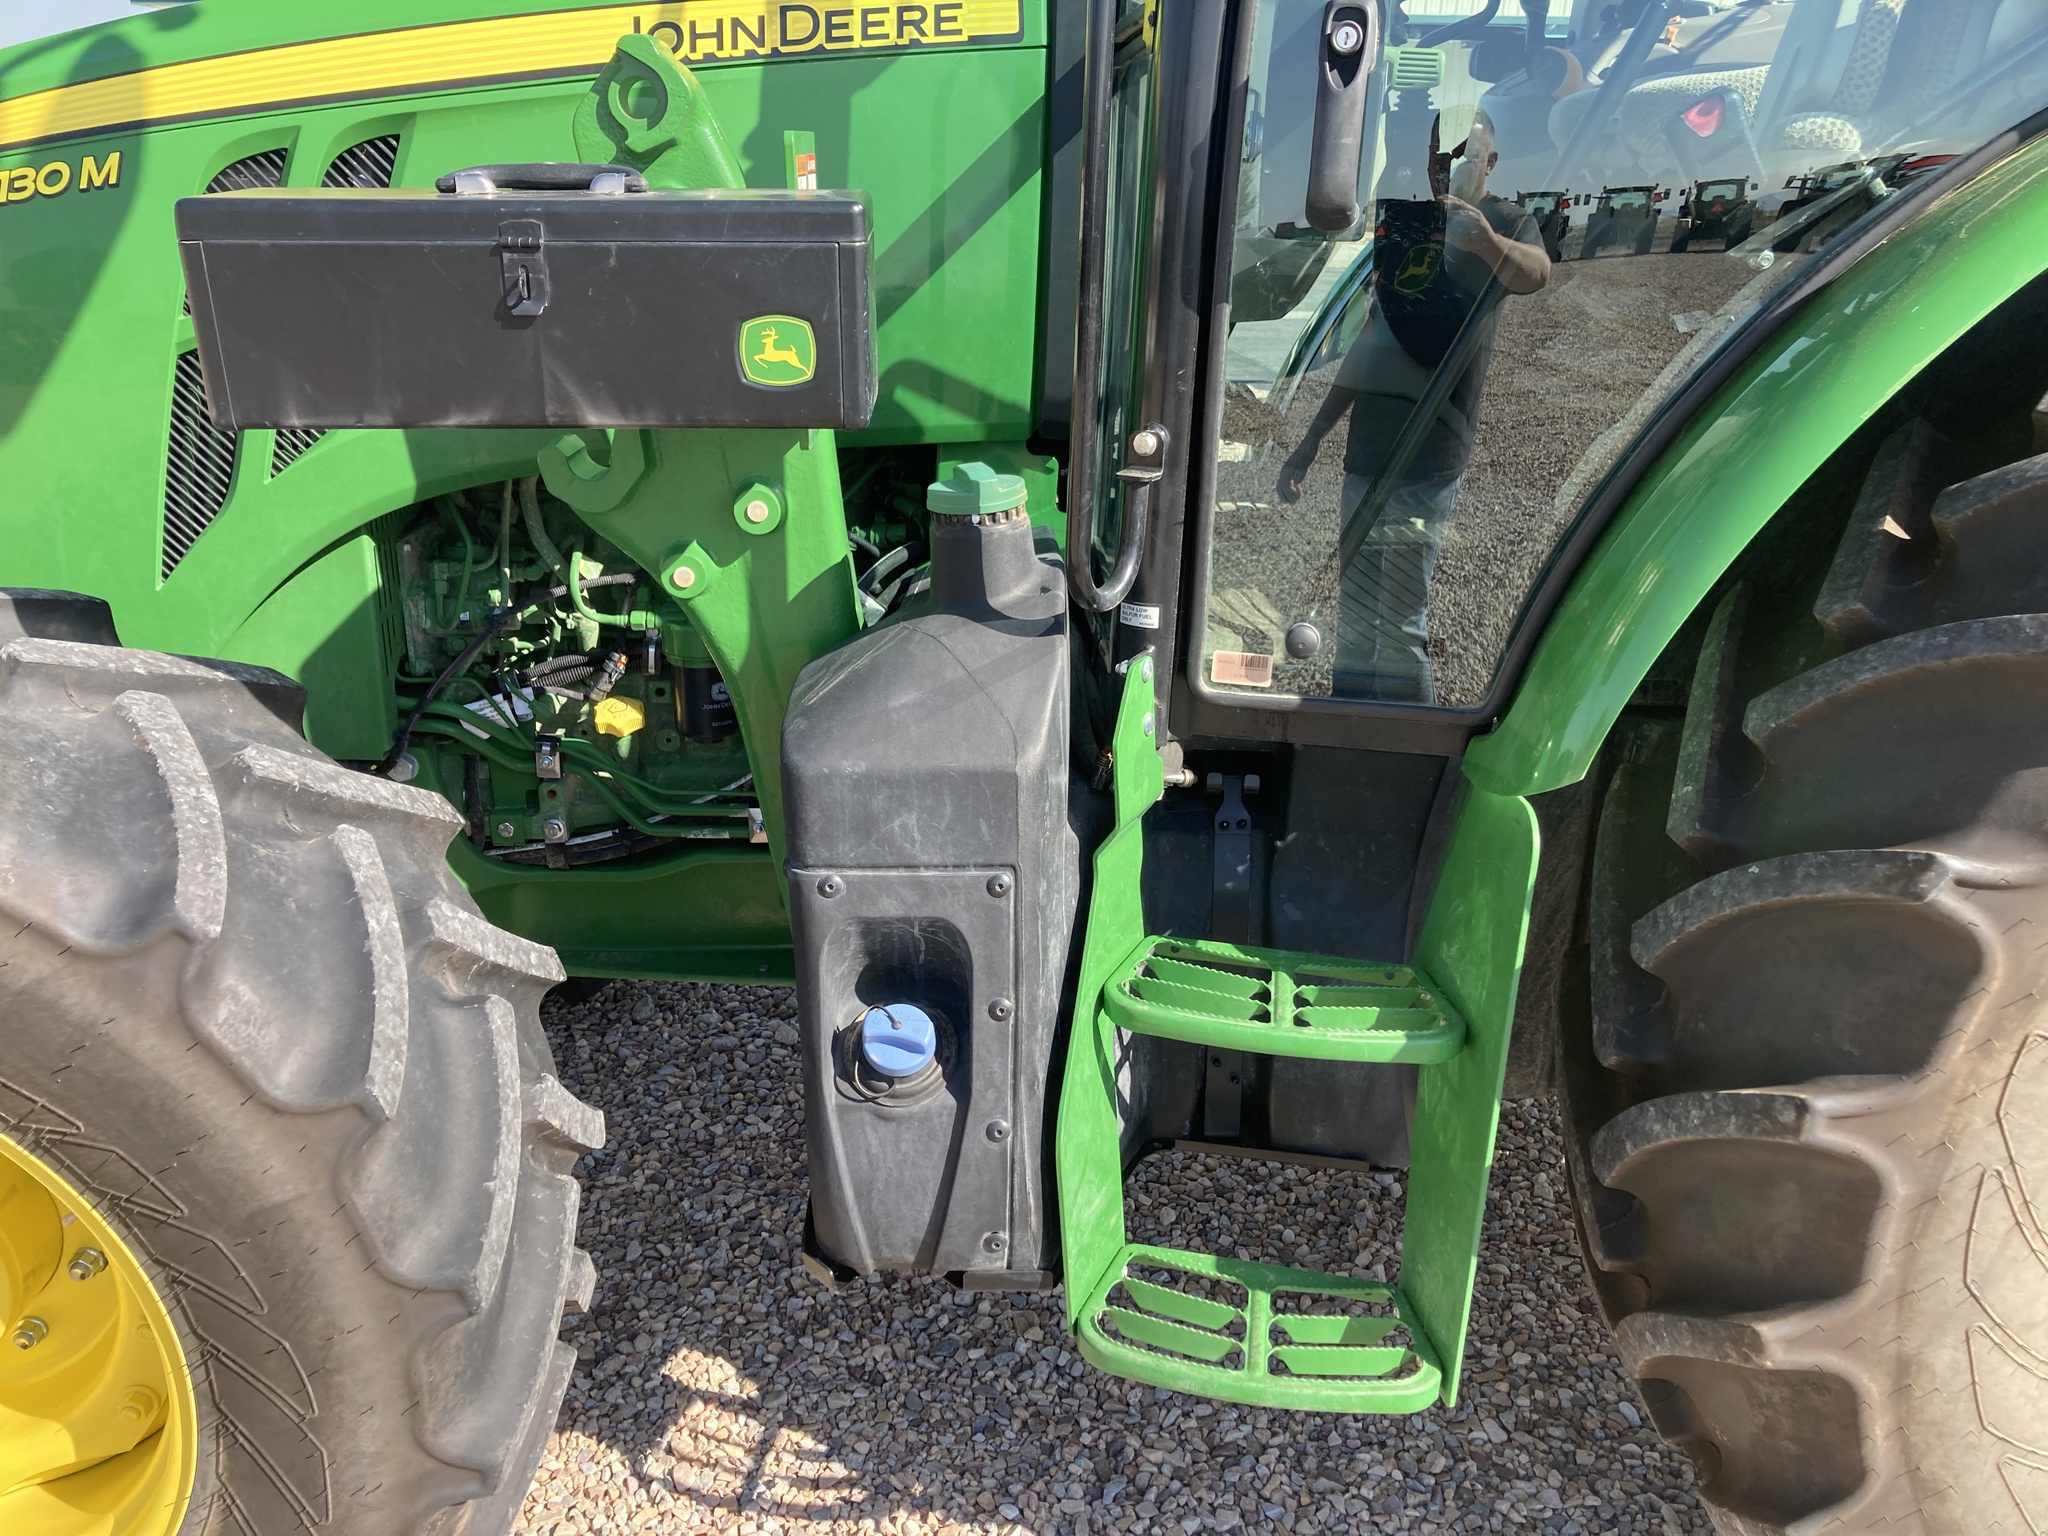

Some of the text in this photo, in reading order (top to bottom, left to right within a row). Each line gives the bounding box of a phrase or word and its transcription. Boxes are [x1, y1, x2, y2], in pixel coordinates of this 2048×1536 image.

[778, 2, 964, 48] DEERE
[78, 150, 122, 192] M
[1122, 610, 1138, 618] SULFUR
